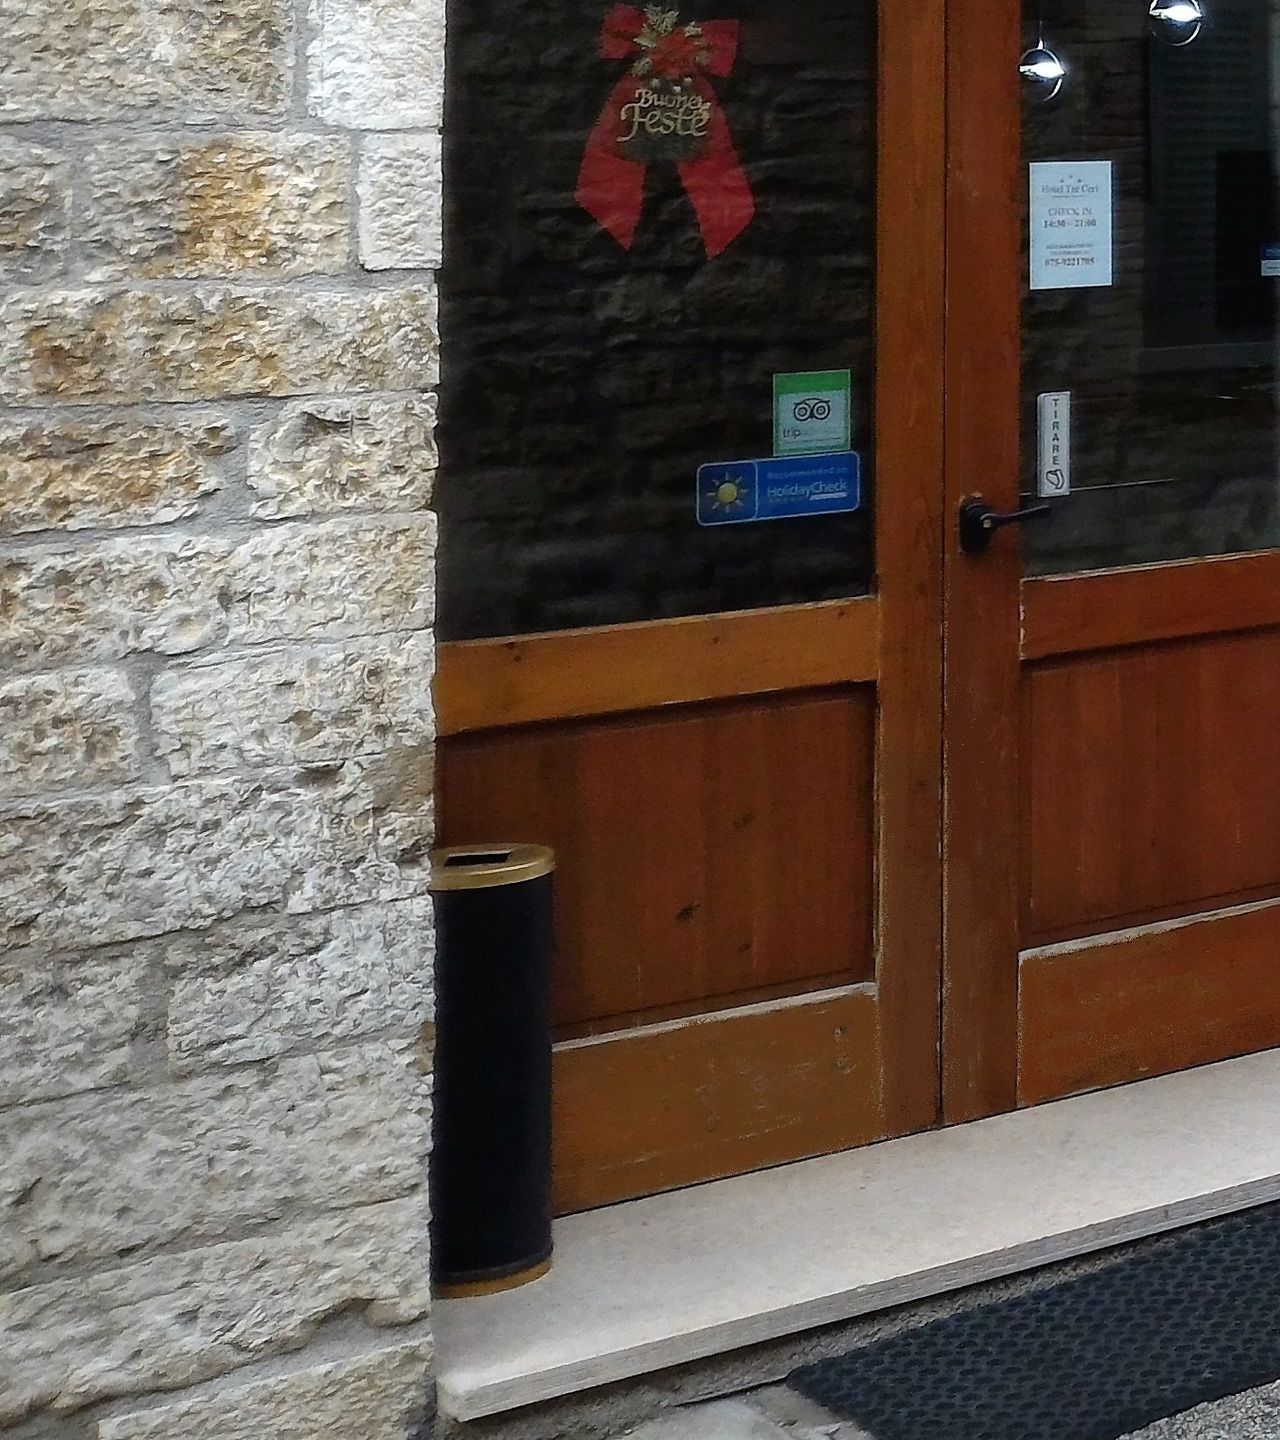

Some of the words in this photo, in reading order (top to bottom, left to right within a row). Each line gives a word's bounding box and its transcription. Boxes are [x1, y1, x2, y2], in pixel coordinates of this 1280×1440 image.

[616, 103, 710, 142] Feste
[1042, 184, 1064, 194] Hotel
[1066, 184, 1081, 194] Tre
[1081, 184, 1099, 194] Ceri
[1048, 207, 1078, 217] CHECK
[1081, 207, 1092, 216] IN
[1052, 398, 1060, 466] TIRARE
[767, 479, 848, 498] HolidayCheck
